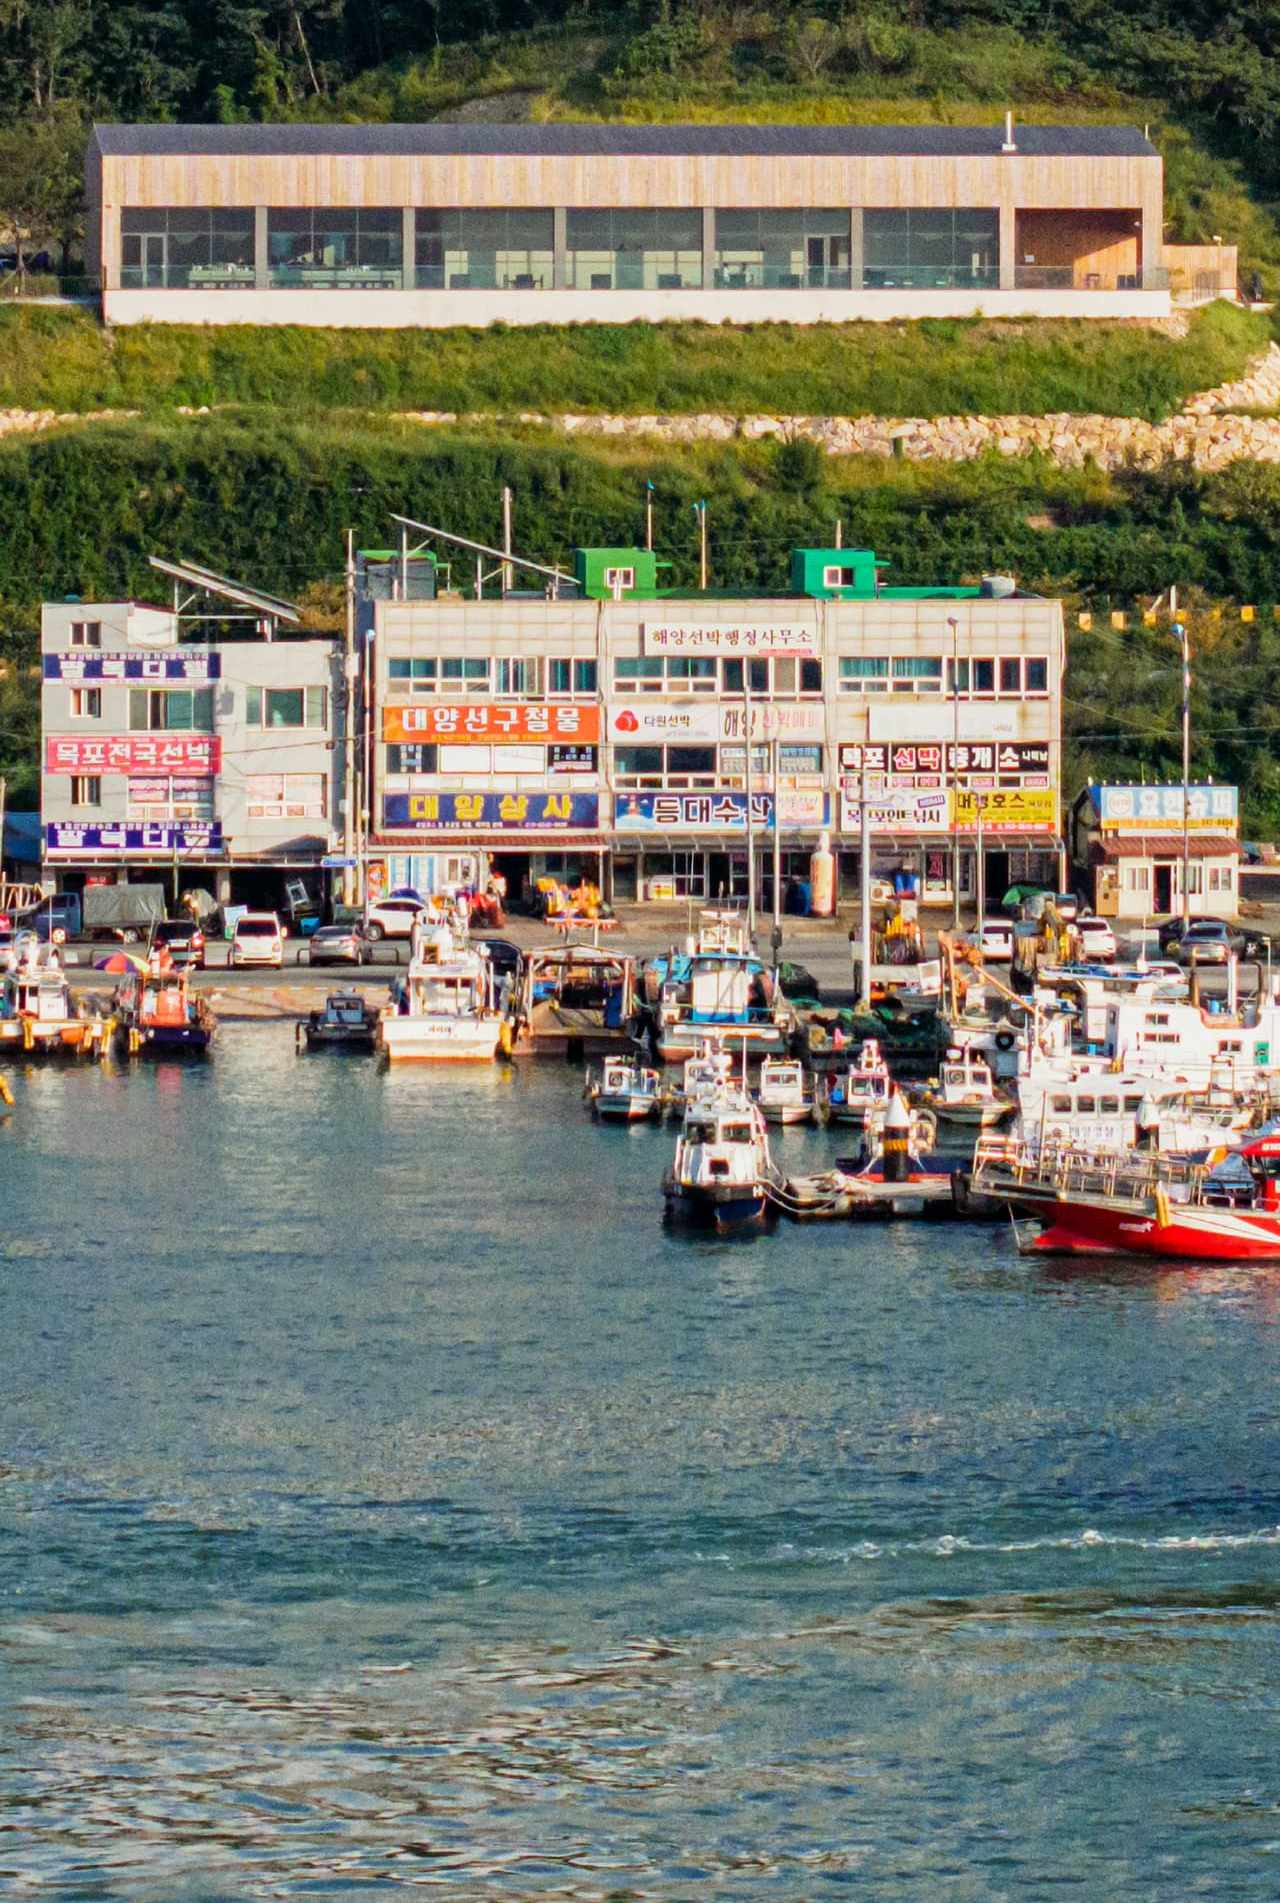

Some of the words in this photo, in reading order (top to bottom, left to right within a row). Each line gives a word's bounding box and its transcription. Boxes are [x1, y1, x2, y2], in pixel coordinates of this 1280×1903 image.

[652, 628, 813, 646] 해양선박행정사무소
[401, 706, 581, 733] 대양선구철물
[408, 794, 574, 821] 대양상사
[654, 797, 772, 824] 등대수산
